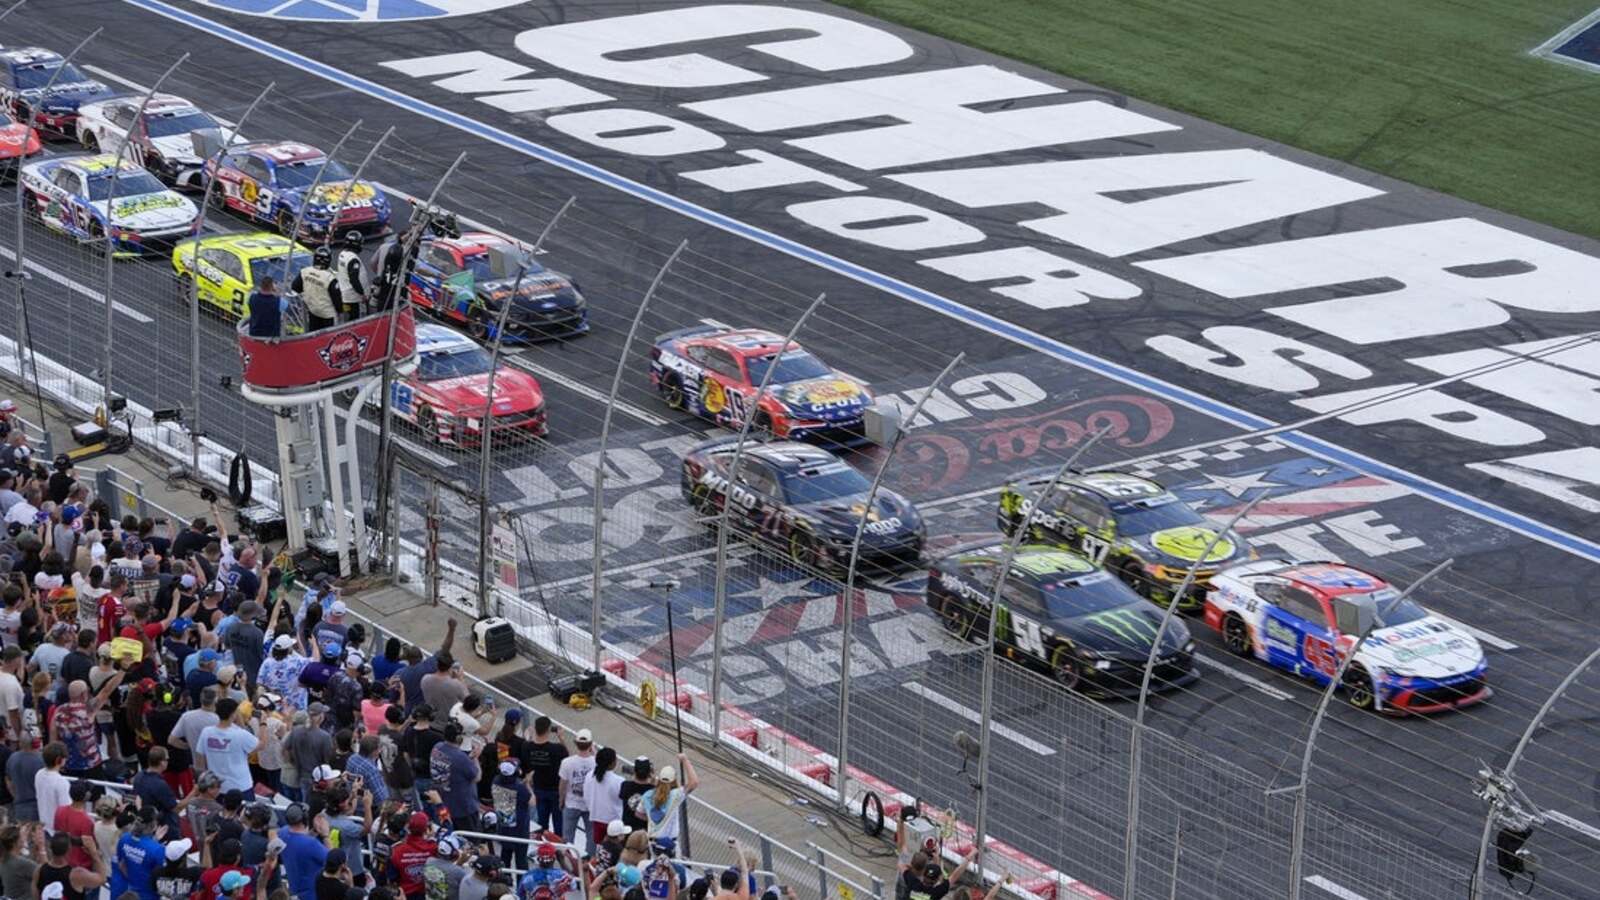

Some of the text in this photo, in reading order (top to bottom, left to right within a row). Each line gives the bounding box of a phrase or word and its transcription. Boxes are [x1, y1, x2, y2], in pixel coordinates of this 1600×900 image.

[378, 50, 1142, 310] MOTOR
[257, 187, 274, 215] 3
[231, 288, 245, 316] 2
[1082, 533, 1111, 567] 97
[1011, 610, 1048, 660] 54
